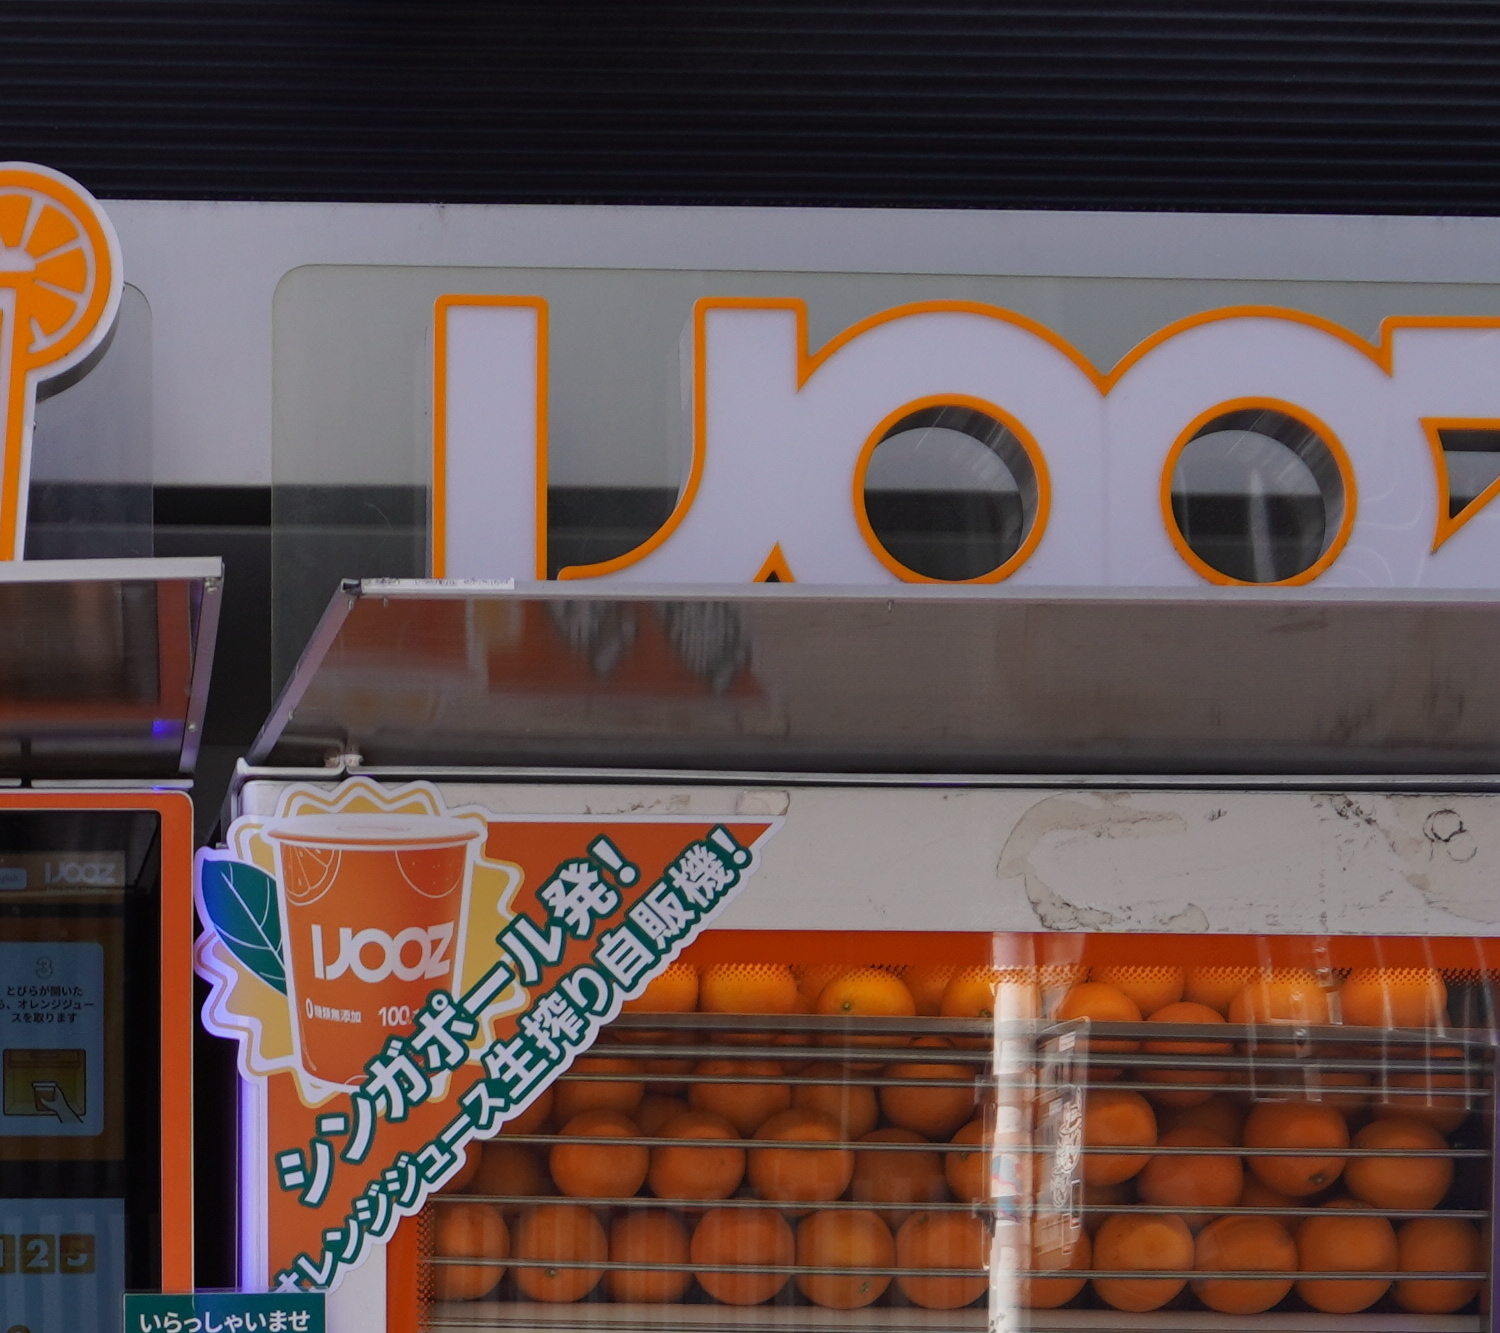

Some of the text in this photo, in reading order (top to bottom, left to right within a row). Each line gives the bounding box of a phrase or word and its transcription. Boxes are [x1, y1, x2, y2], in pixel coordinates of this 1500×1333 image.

[278, 839, 638, 1205] シンガポール発!
[140, 1310, 310, 1333] いらっしゃいませ
